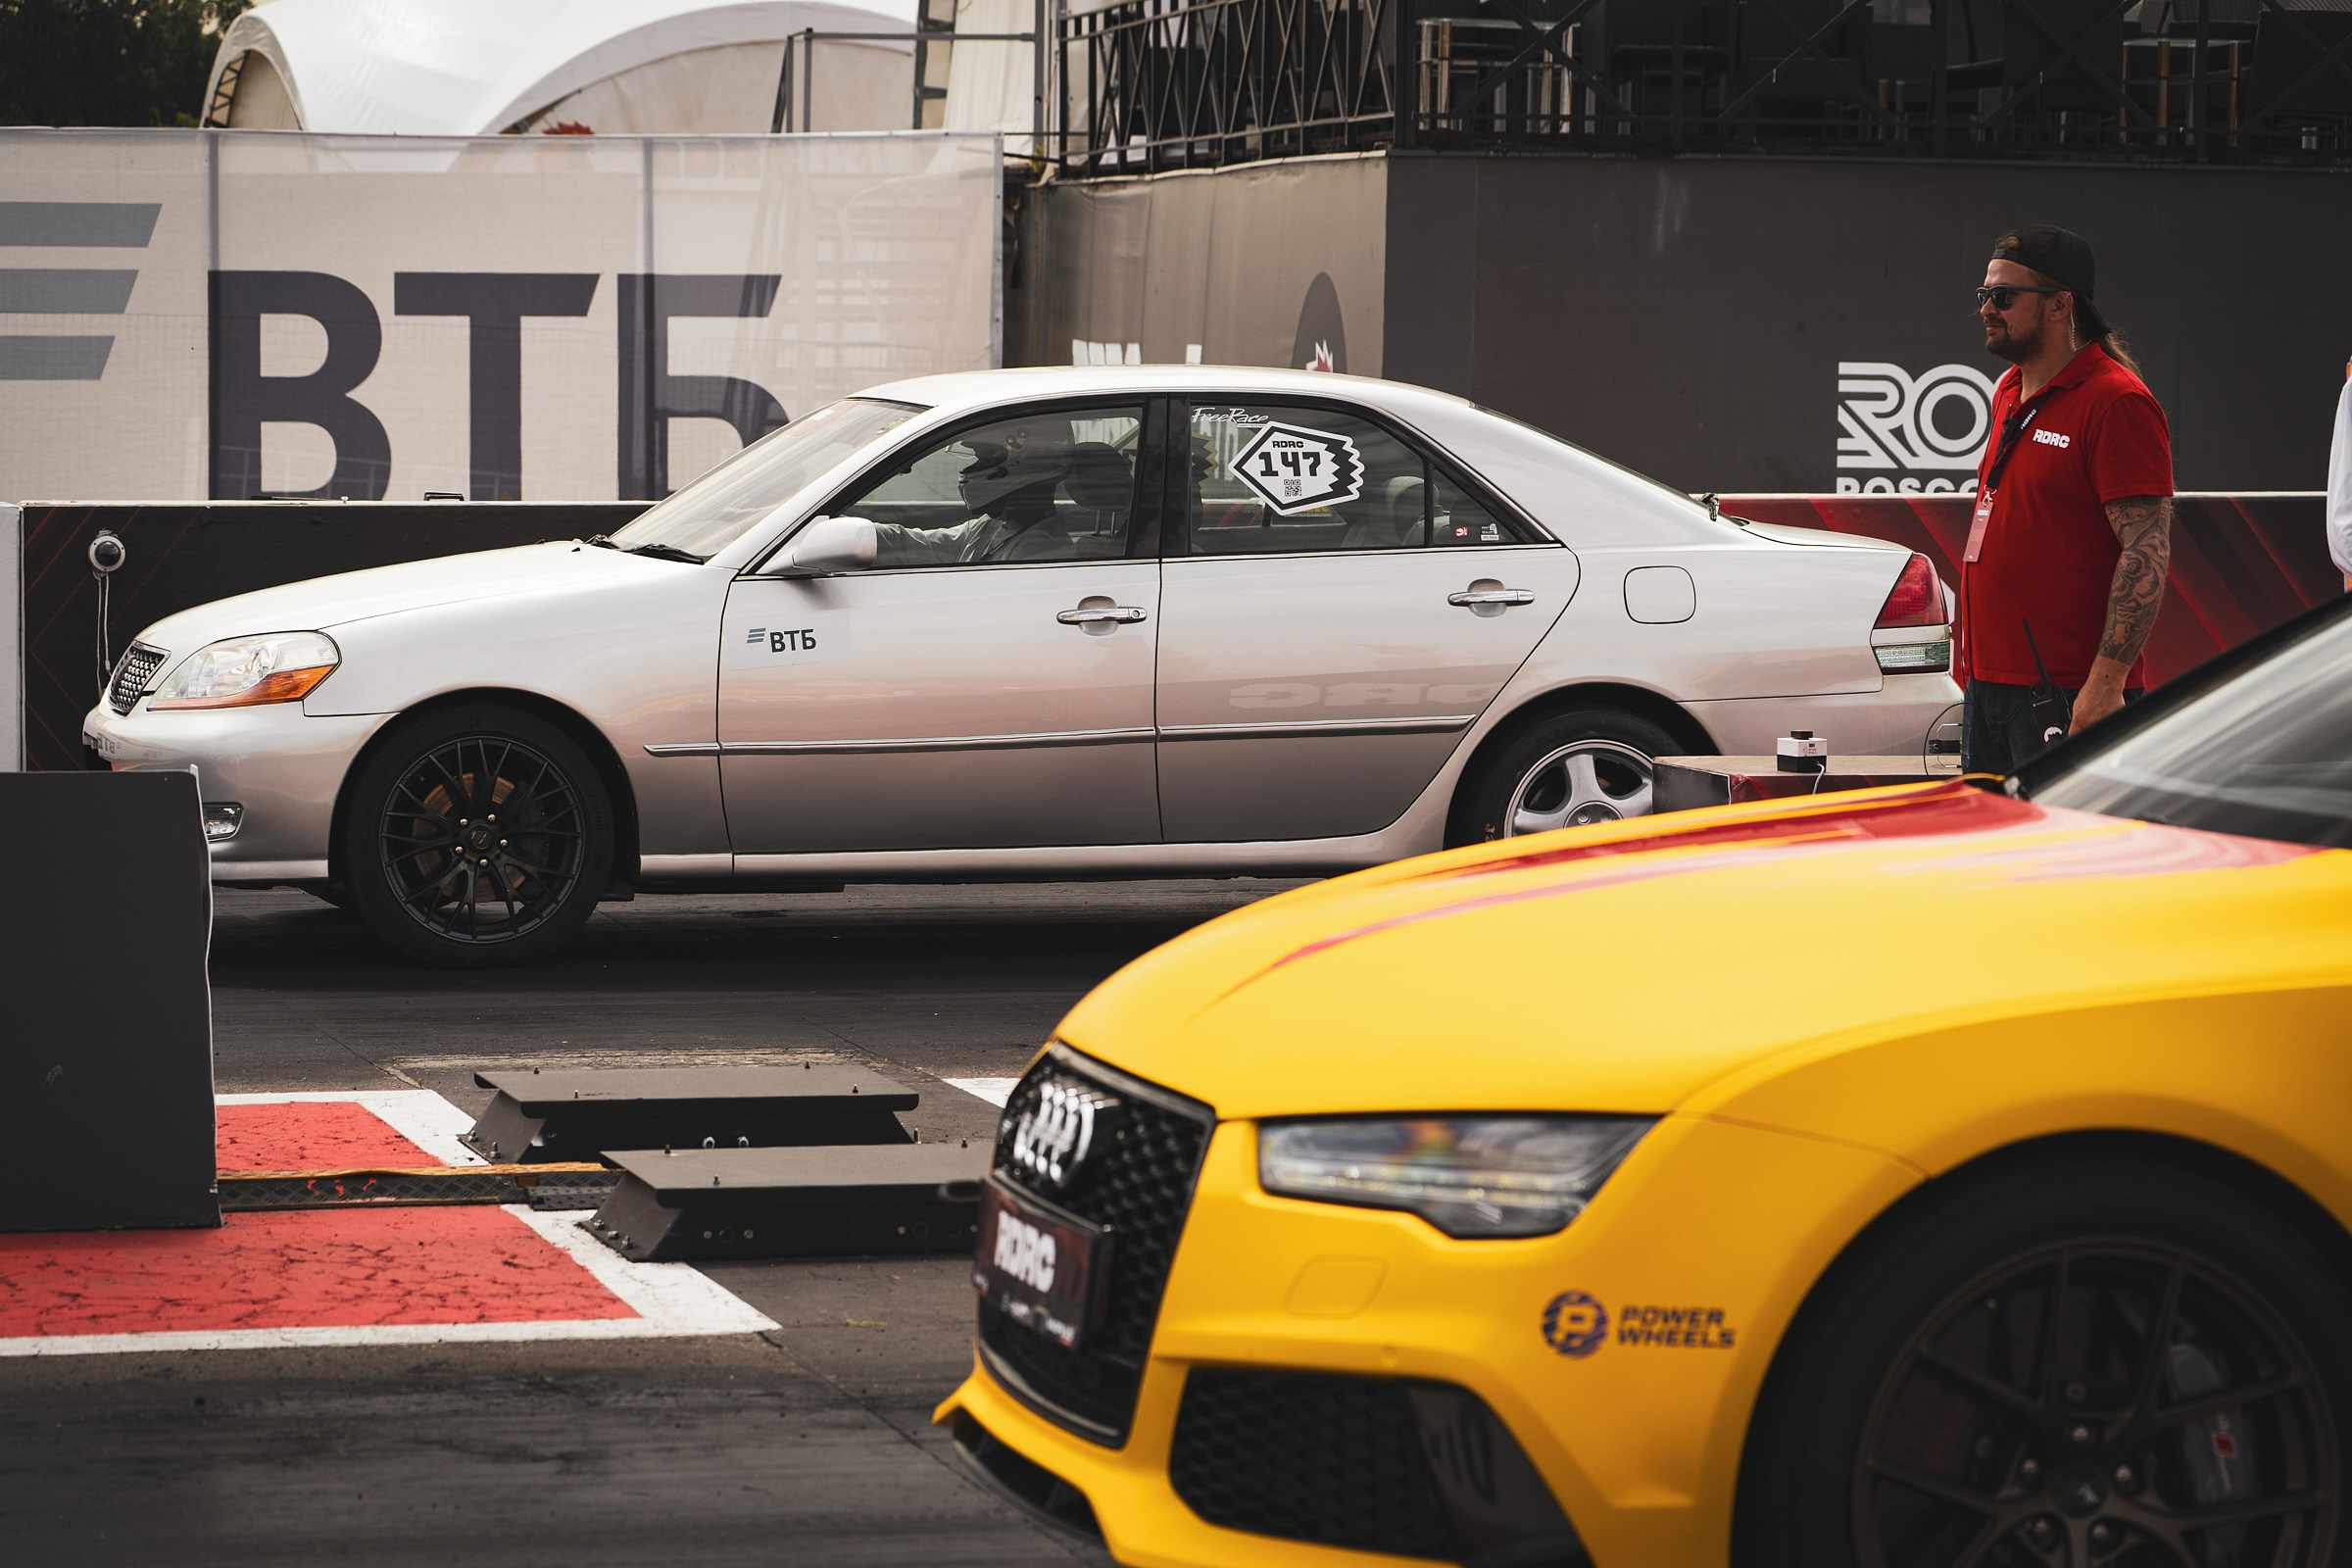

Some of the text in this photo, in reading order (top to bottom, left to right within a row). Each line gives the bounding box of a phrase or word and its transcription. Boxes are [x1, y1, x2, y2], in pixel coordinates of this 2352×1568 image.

[208, 270, 789, 502] ВТБ
[1837, 362, 2011, 469] RO
[2033, 428, 2071, 449] RDRC
[1258, 452, 1321, 477] 147
[769, 628, 817, 654] ВТБ
[1621, 1305, 1726, 1328] POWER
[1618, 1328, 1737, 1349] WHEELS
